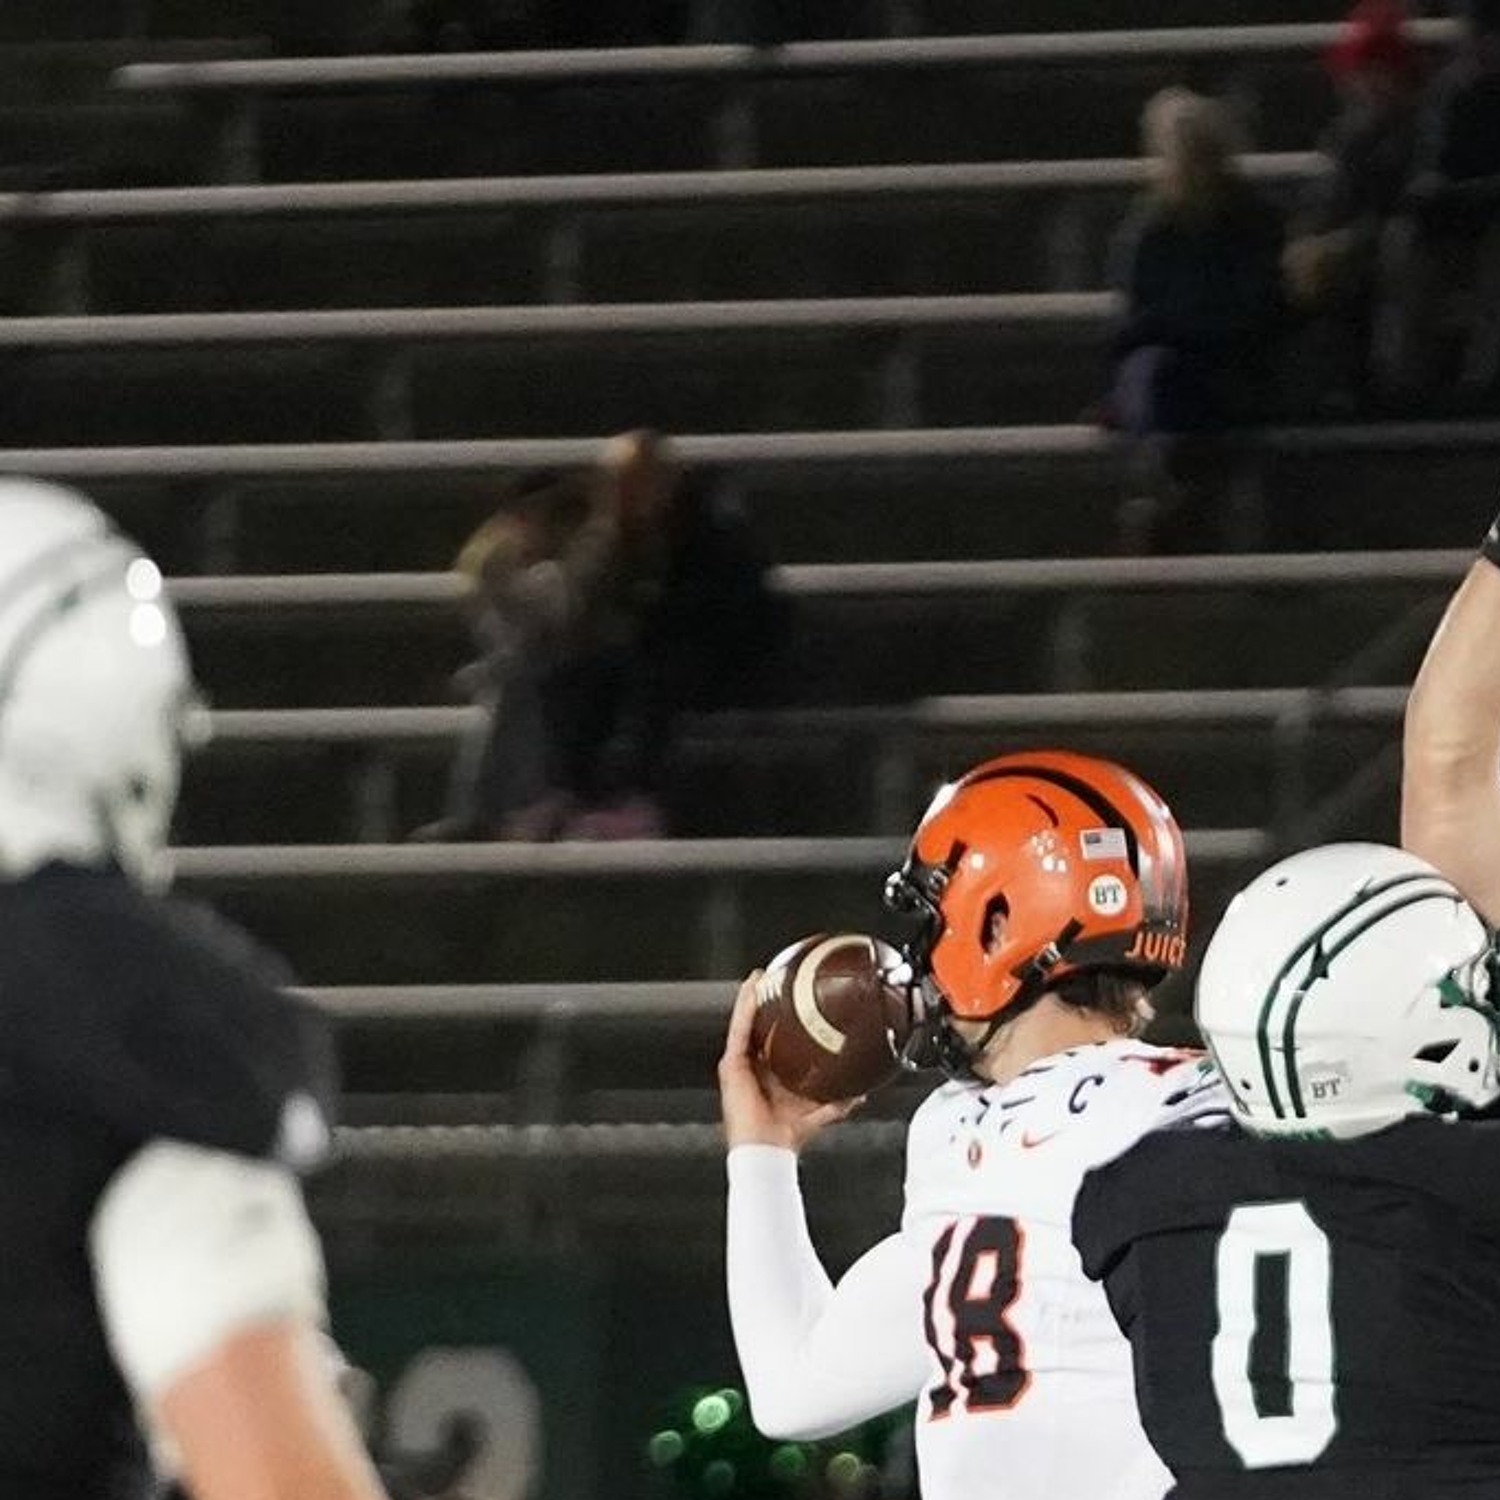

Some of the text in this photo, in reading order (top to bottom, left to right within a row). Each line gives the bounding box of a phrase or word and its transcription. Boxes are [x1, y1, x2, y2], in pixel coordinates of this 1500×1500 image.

[1094, 882, 1122, 905] BT
[1311, 1078, 1341, 1099] BT
[922, 1211, 1034, 1423] 18
[1211, 1201, 1339, 1471] 0
